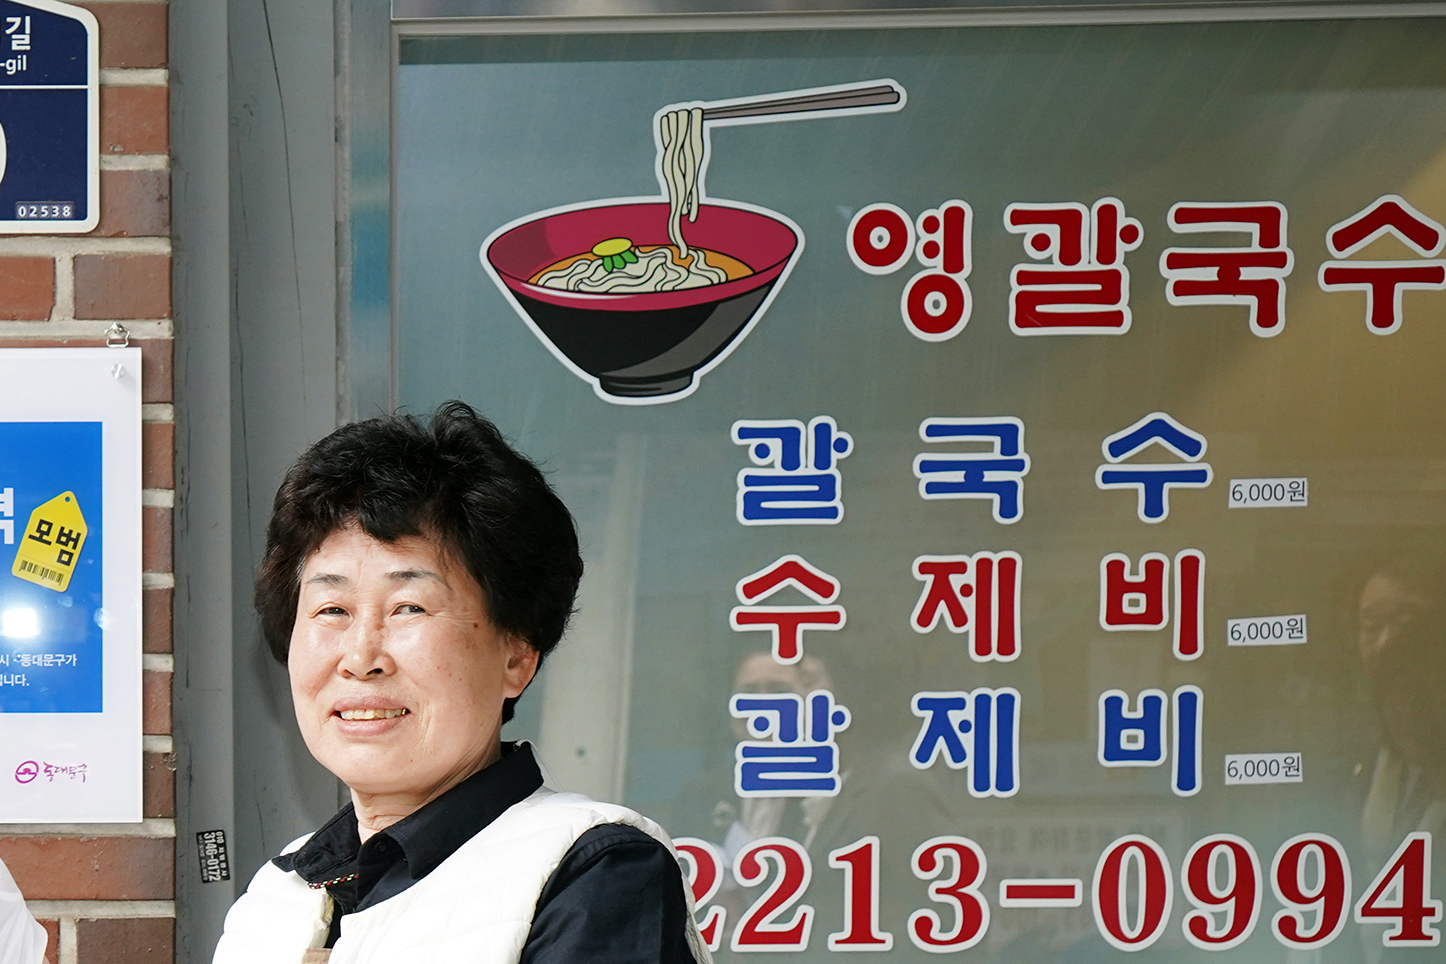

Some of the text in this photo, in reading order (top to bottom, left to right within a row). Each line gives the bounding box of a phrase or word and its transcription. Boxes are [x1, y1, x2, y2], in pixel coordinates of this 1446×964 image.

[18, 205, 71, 217] 02538
[846, 194, 1446, 342] 영칼국수
[731, 412, 1305, 525] 칼국수 6,000원
[28, 518, 81, 566] 모범
[20, 654, 77, 667] 동대문구가
[730, 549, 1304, 663] 수제비 6,000원
[729, 686, 1300, 797] 칼제비 6,000원
